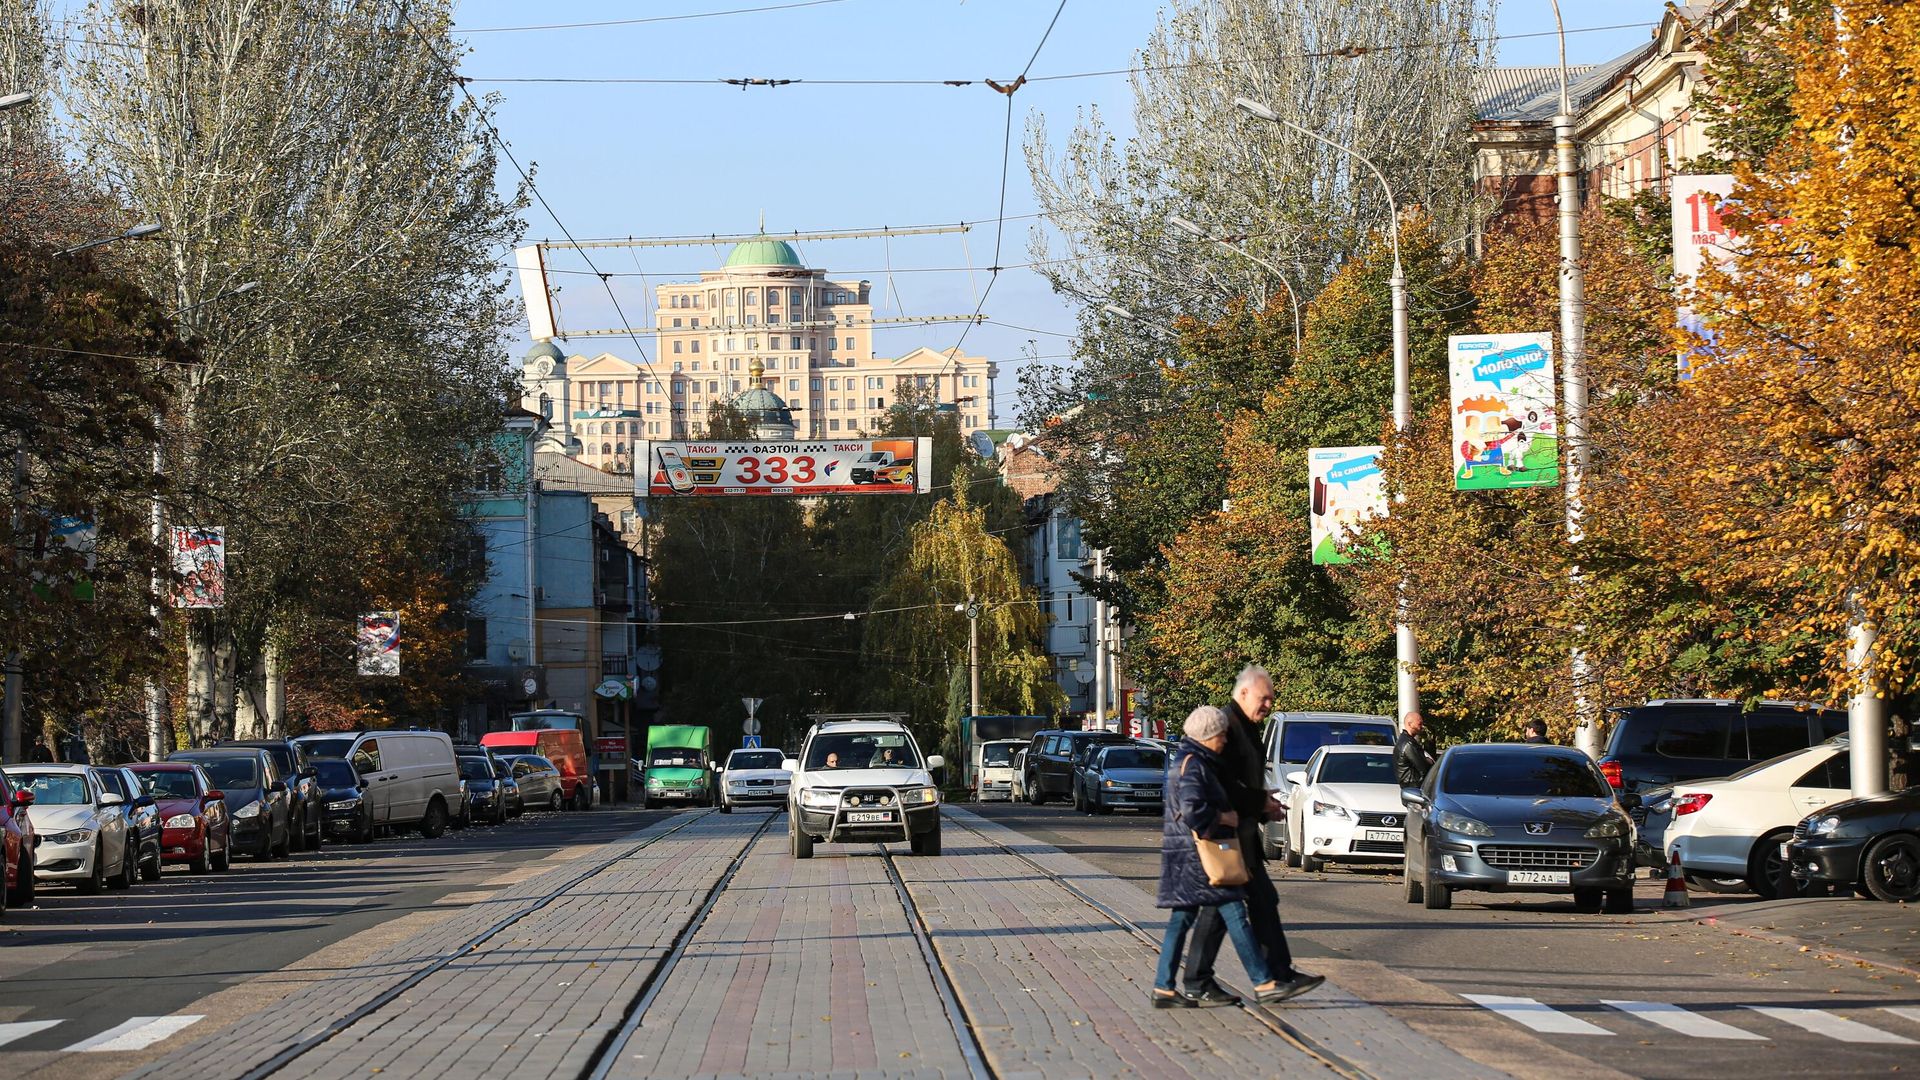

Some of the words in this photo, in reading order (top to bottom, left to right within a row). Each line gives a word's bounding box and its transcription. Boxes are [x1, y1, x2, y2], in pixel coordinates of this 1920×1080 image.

[1691, 234, 1717, 246] мая
[1477, 352, 1543, 377] МОЛОЧНО!
[687, 445, 717, 454] ТАКСИ
[752, 445, 799, 454] ФАЭТОН
[833, 444, 863, 452] ТАКСИ
[735, 456, 817, 484] 333
[1330, 471, 1343, 479] На
[1512, 872, 1554, 883] А772АА
